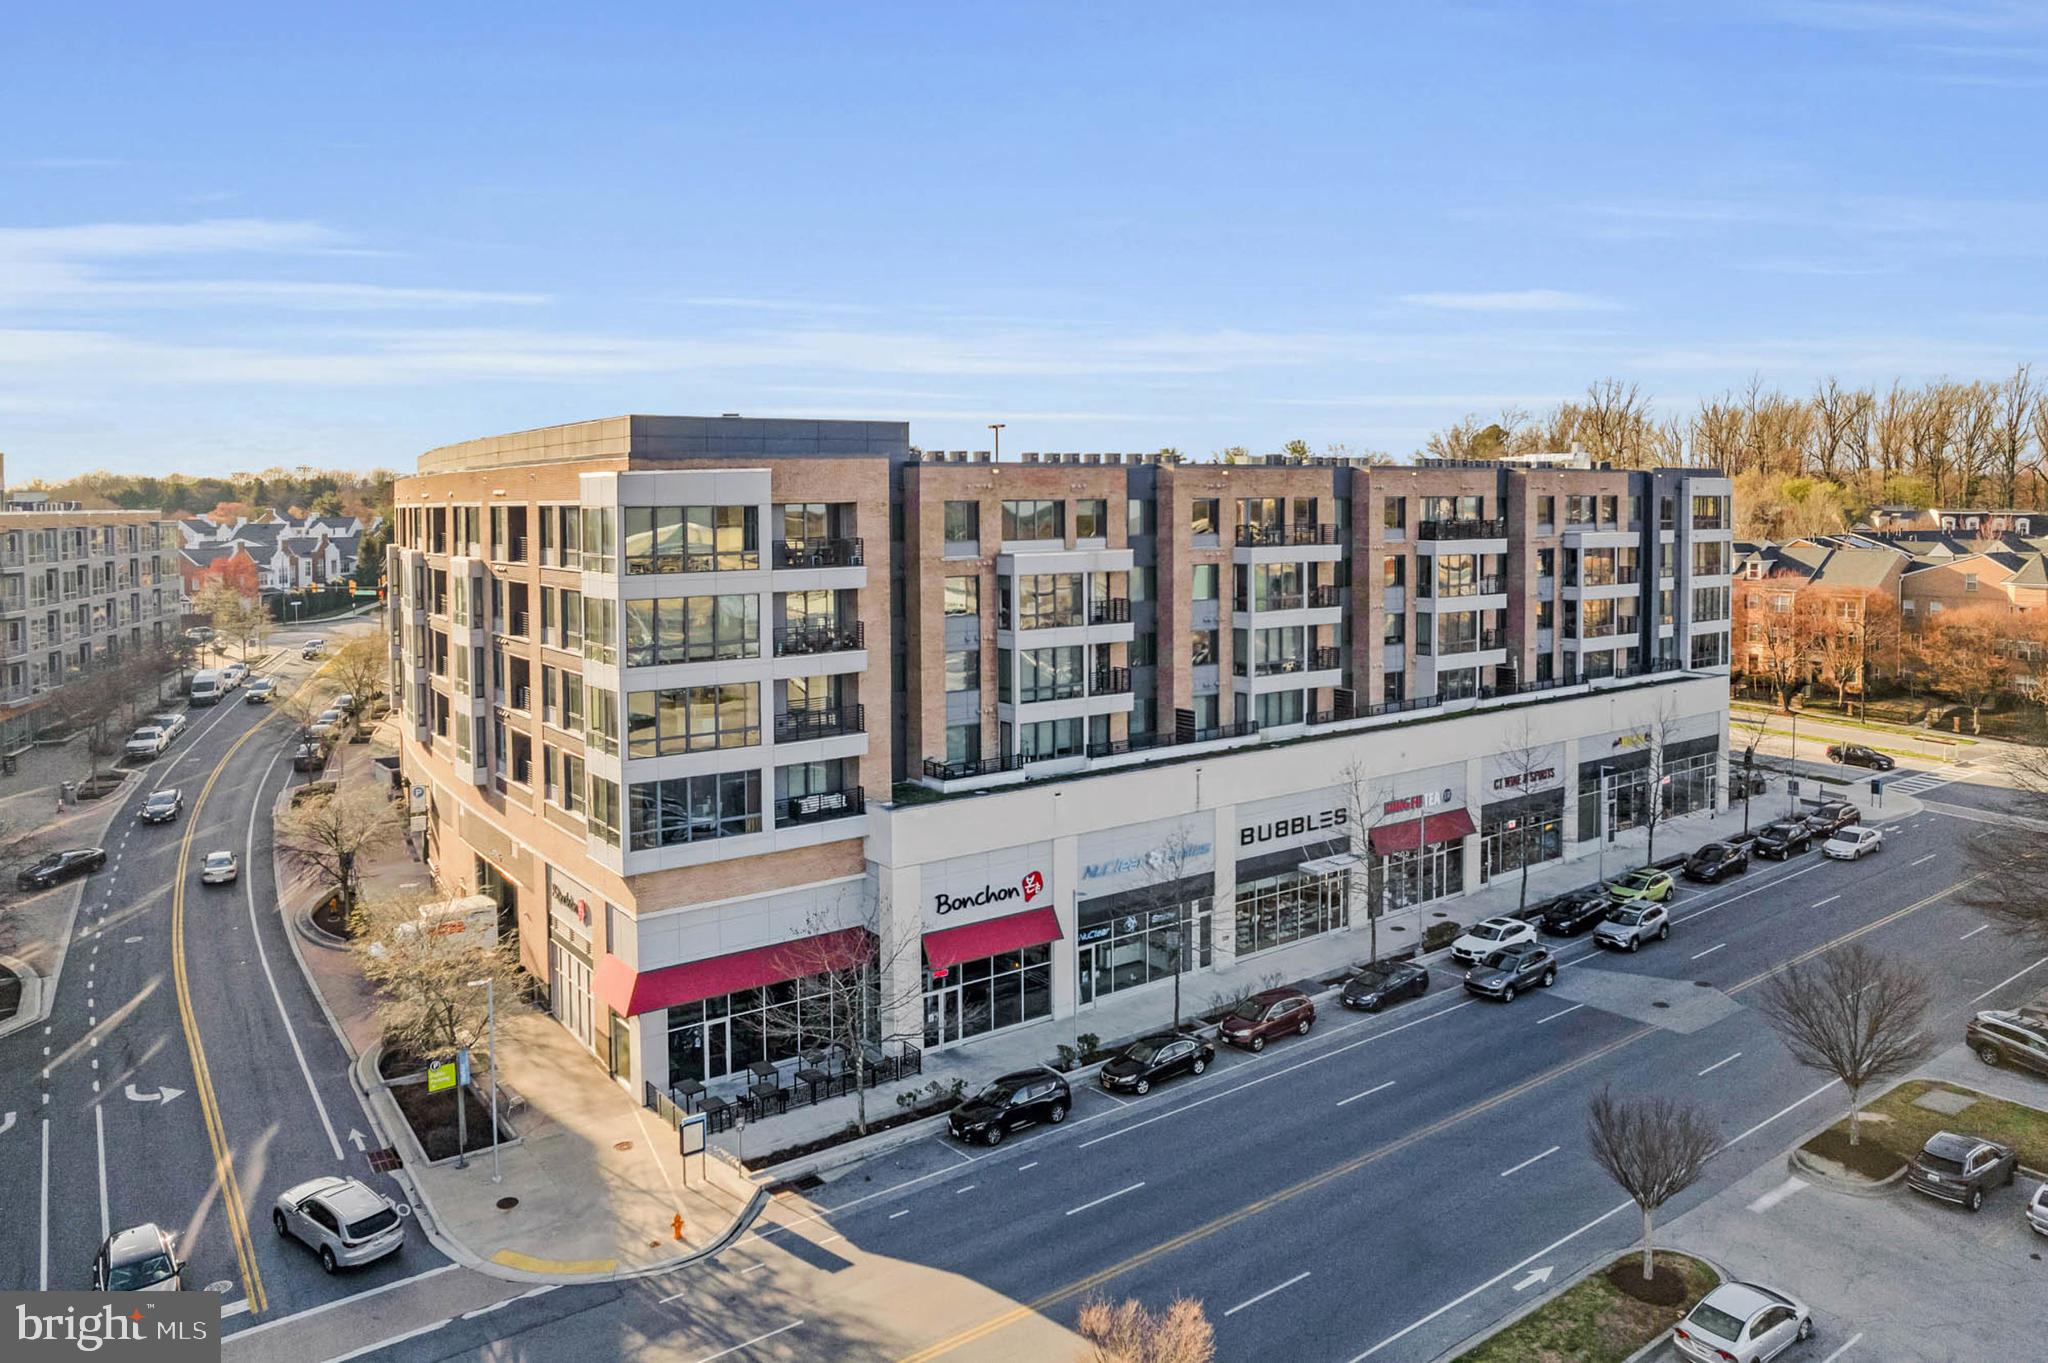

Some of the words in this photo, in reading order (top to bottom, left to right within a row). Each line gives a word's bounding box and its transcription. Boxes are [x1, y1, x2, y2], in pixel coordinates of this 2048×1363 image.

[1423, 790, 1441, 808] TEA
[1240, 808, 1347, 846] BUBBLES
[935, 884, 1020, 915] Bonchon
